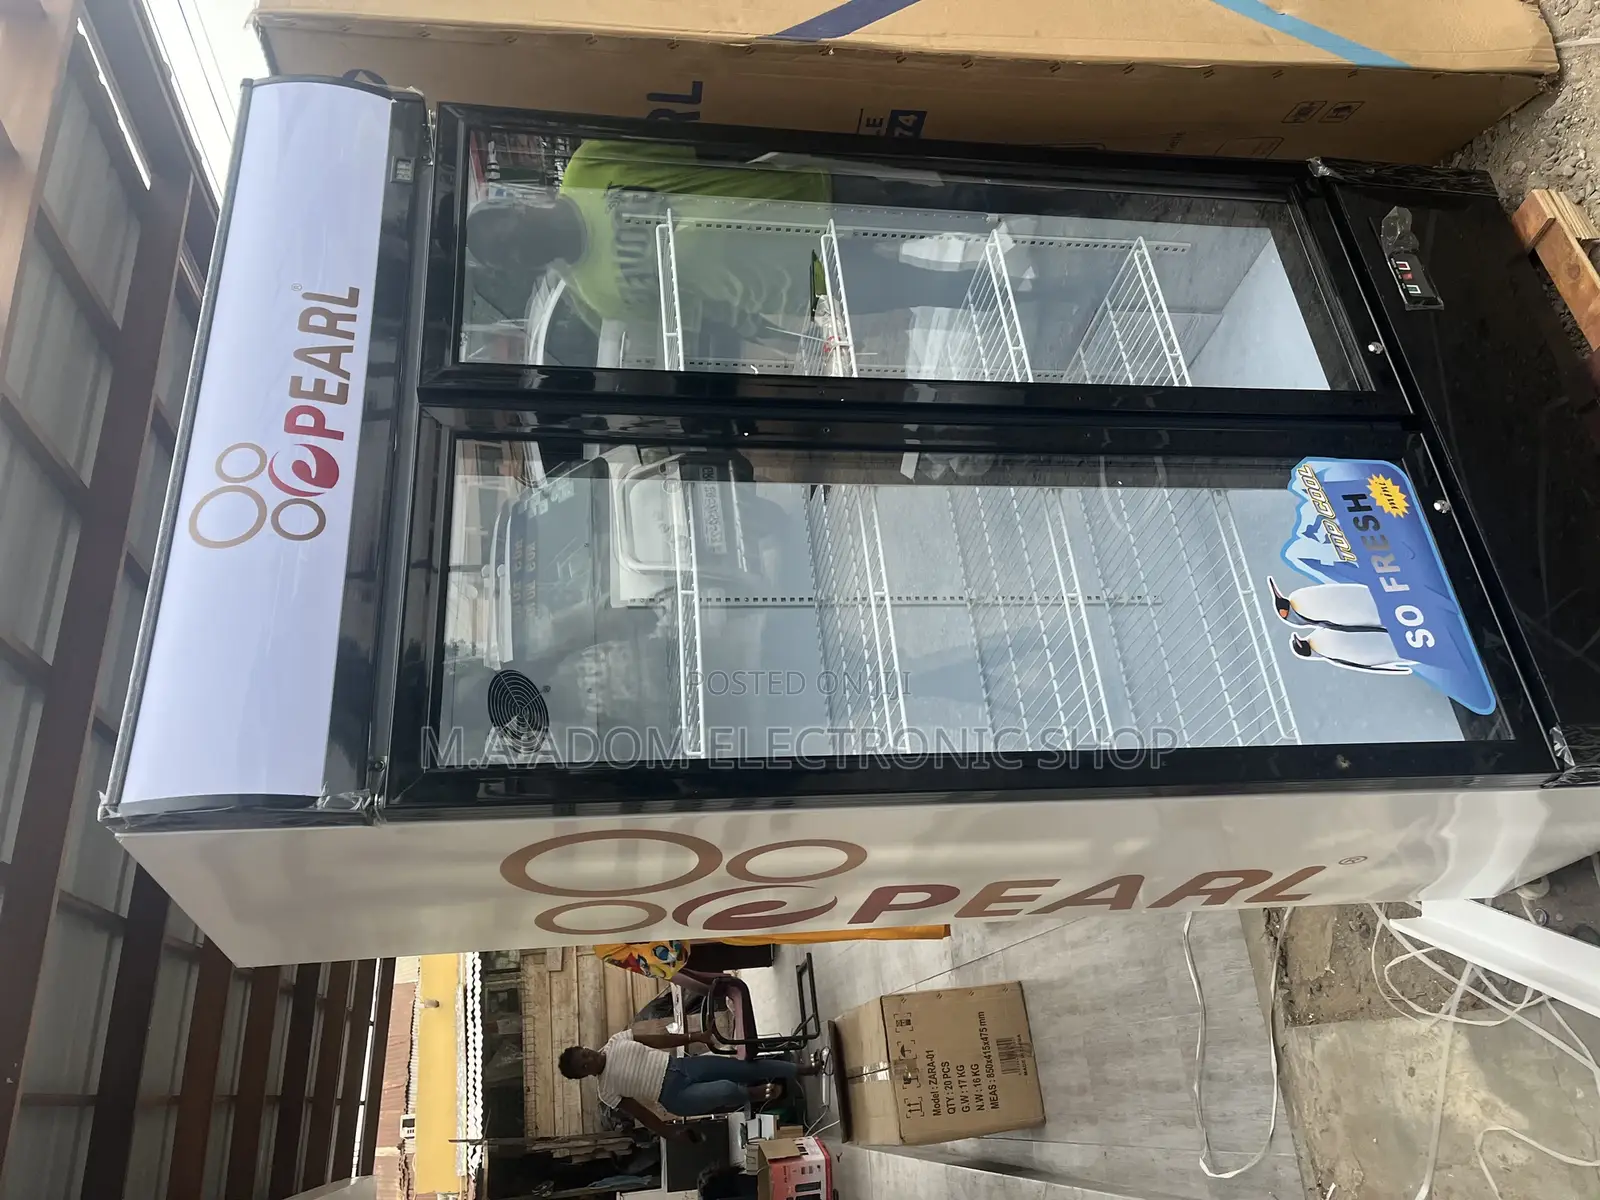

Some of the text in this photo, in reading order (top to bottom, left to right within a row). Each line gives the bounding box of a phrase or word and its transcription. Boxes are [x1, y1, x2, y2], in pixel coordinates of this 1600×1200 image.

[284, 286, 360, 441] PEARL
[1375, 480, 1400, 510] mini
[1297, 465, 1357, 562] TOP COOL
[1342, 494, 1436, 648] SO FRESH
[848, 865, 1327, 925] PEARL
[978, 1011, 986, 1026] mm
[979, 1027, 994, 1078] 850x415x475
[926, 1049, 937, 1085] ZARA-01
[942, 1061, 950, 1079] PCS
[956, 1064, 965, 1078] KG
[970, 1063, 979, 1076] KG
[943, 1080, 952, 1090] 20
[958, 1079, 966, 1089] 17
[972, 1076, 981, 1087] 16
